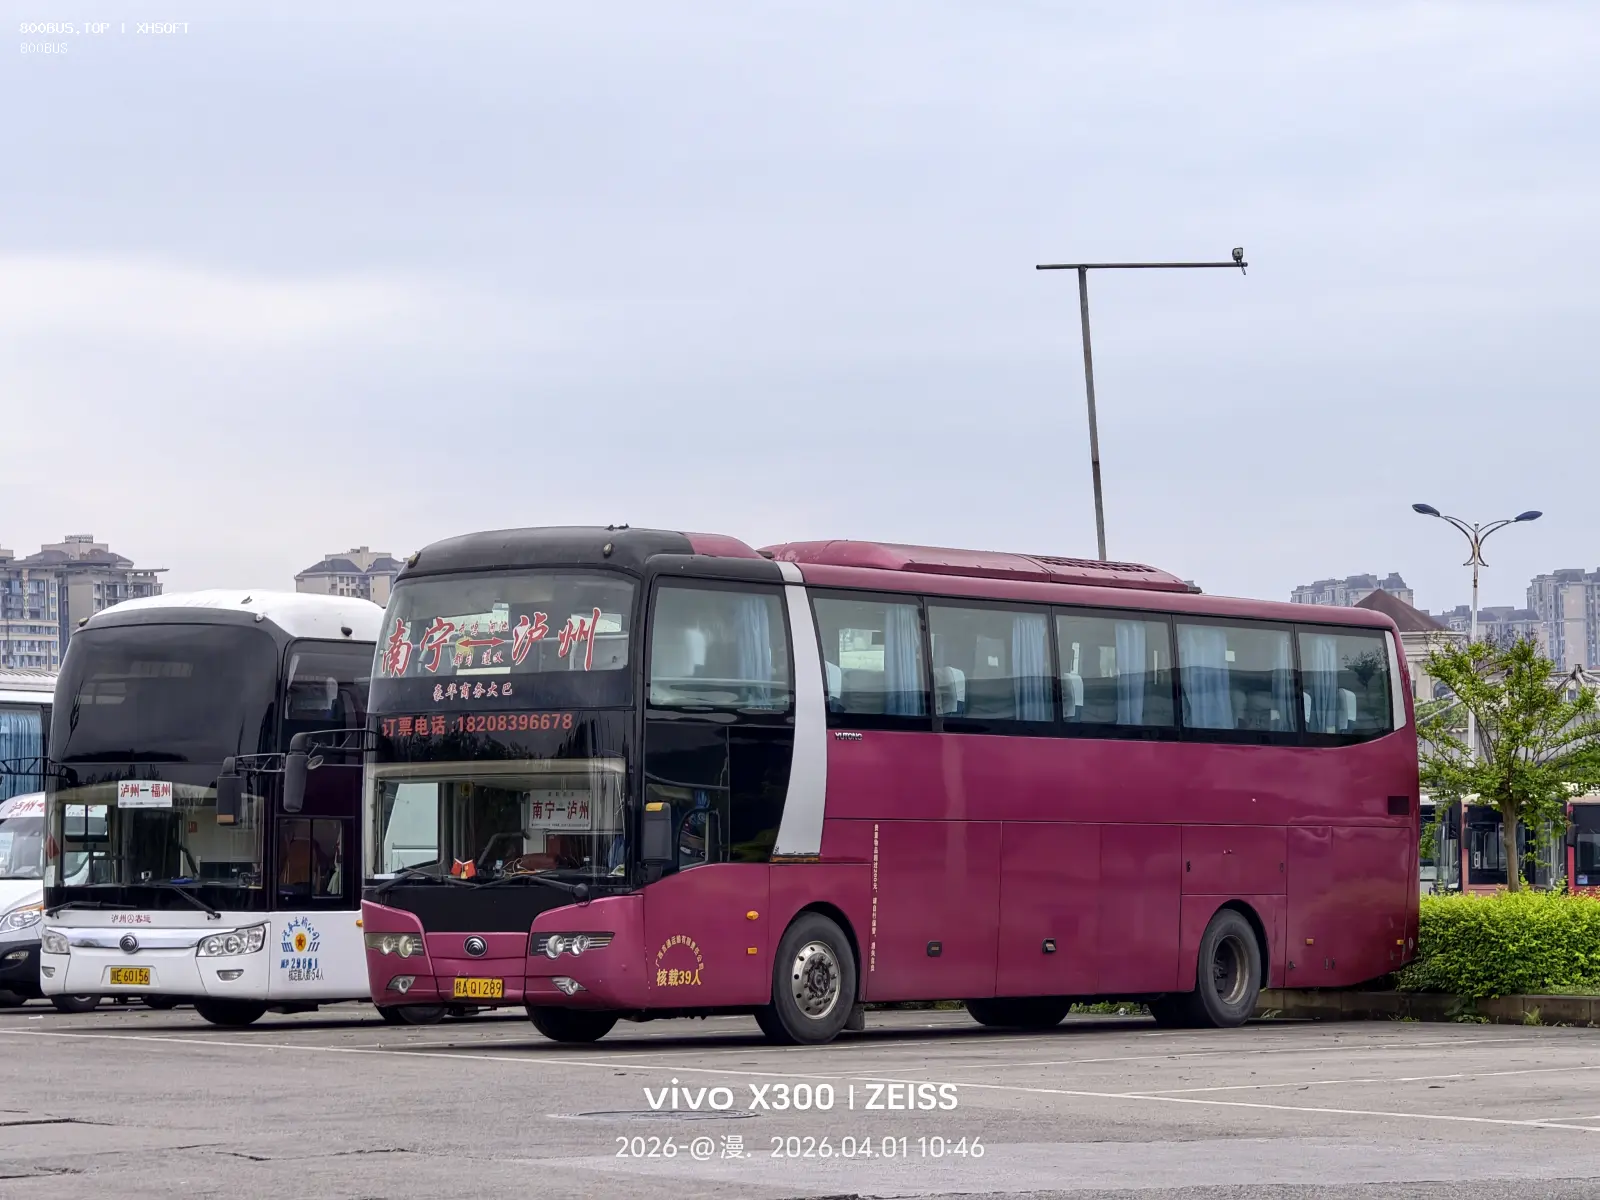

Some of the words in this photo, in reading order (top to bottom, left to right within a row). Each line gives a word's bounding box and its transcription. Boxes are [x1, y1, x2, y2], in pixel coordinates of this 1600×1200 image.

[381, 617, 456, 678] 南宁
[512, 607, 601, 672] 泸州
[433, 681, 513, 701] 豪华商务大巴
[834, 731, 862, 741] YUTONG
[656, 968, 702, 987] 核载39人
